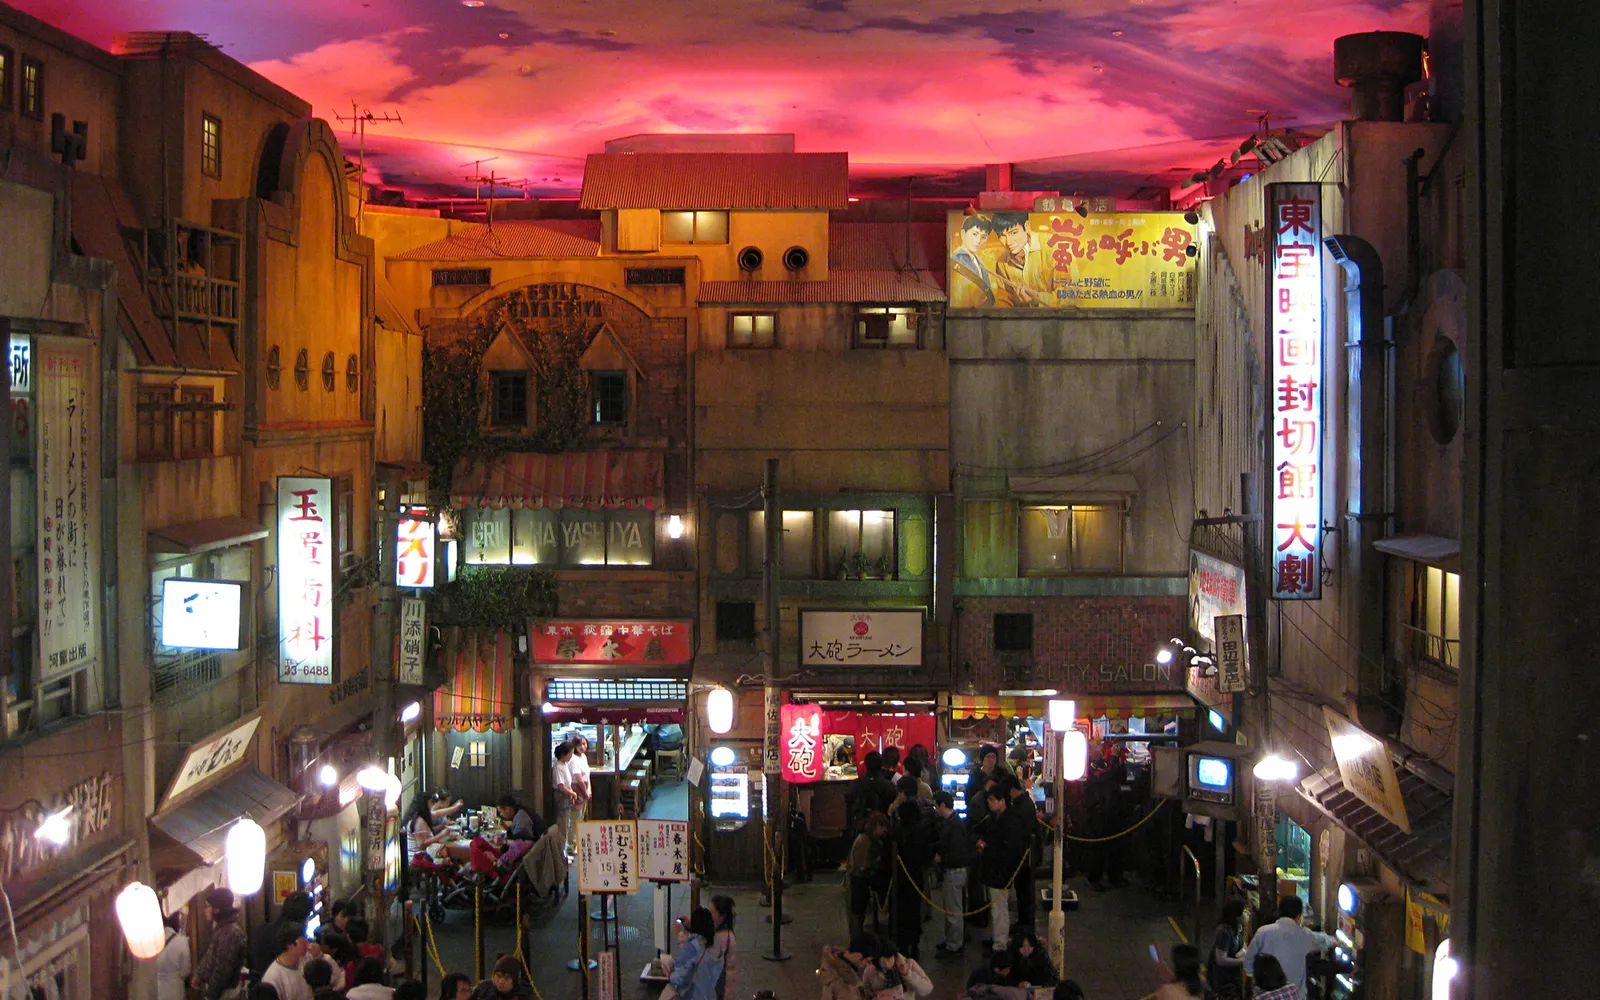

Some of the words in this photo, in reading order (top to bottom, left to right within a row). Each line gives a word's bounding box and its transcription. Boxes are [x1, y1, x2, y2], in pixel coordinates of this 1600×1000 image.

[1047, 218, 1193, 273] 嵐を呼ぶ男
[1051, 277, 1111, 288] ドラムと野望に
[403, 603, 422, 672] 川添硝子
[546, 625, 574, 636] 東京
[808, 639, 913, 662] 大砲ラーメン
[284, 664, 329, 676] 33-6488
[1099, 663, 1171, 682] SALON
[787, 718, 818, 778] 大砲
[859, 724, 906, 751] 大砲
[600, 825, 609, 856] 待ち時間
[616, 834, 630, 888] むらまさ
[672, 832, 684, 875] 春木屋
[600, 862, 612, 872] 15
[602, 878, 610, 887] 分
